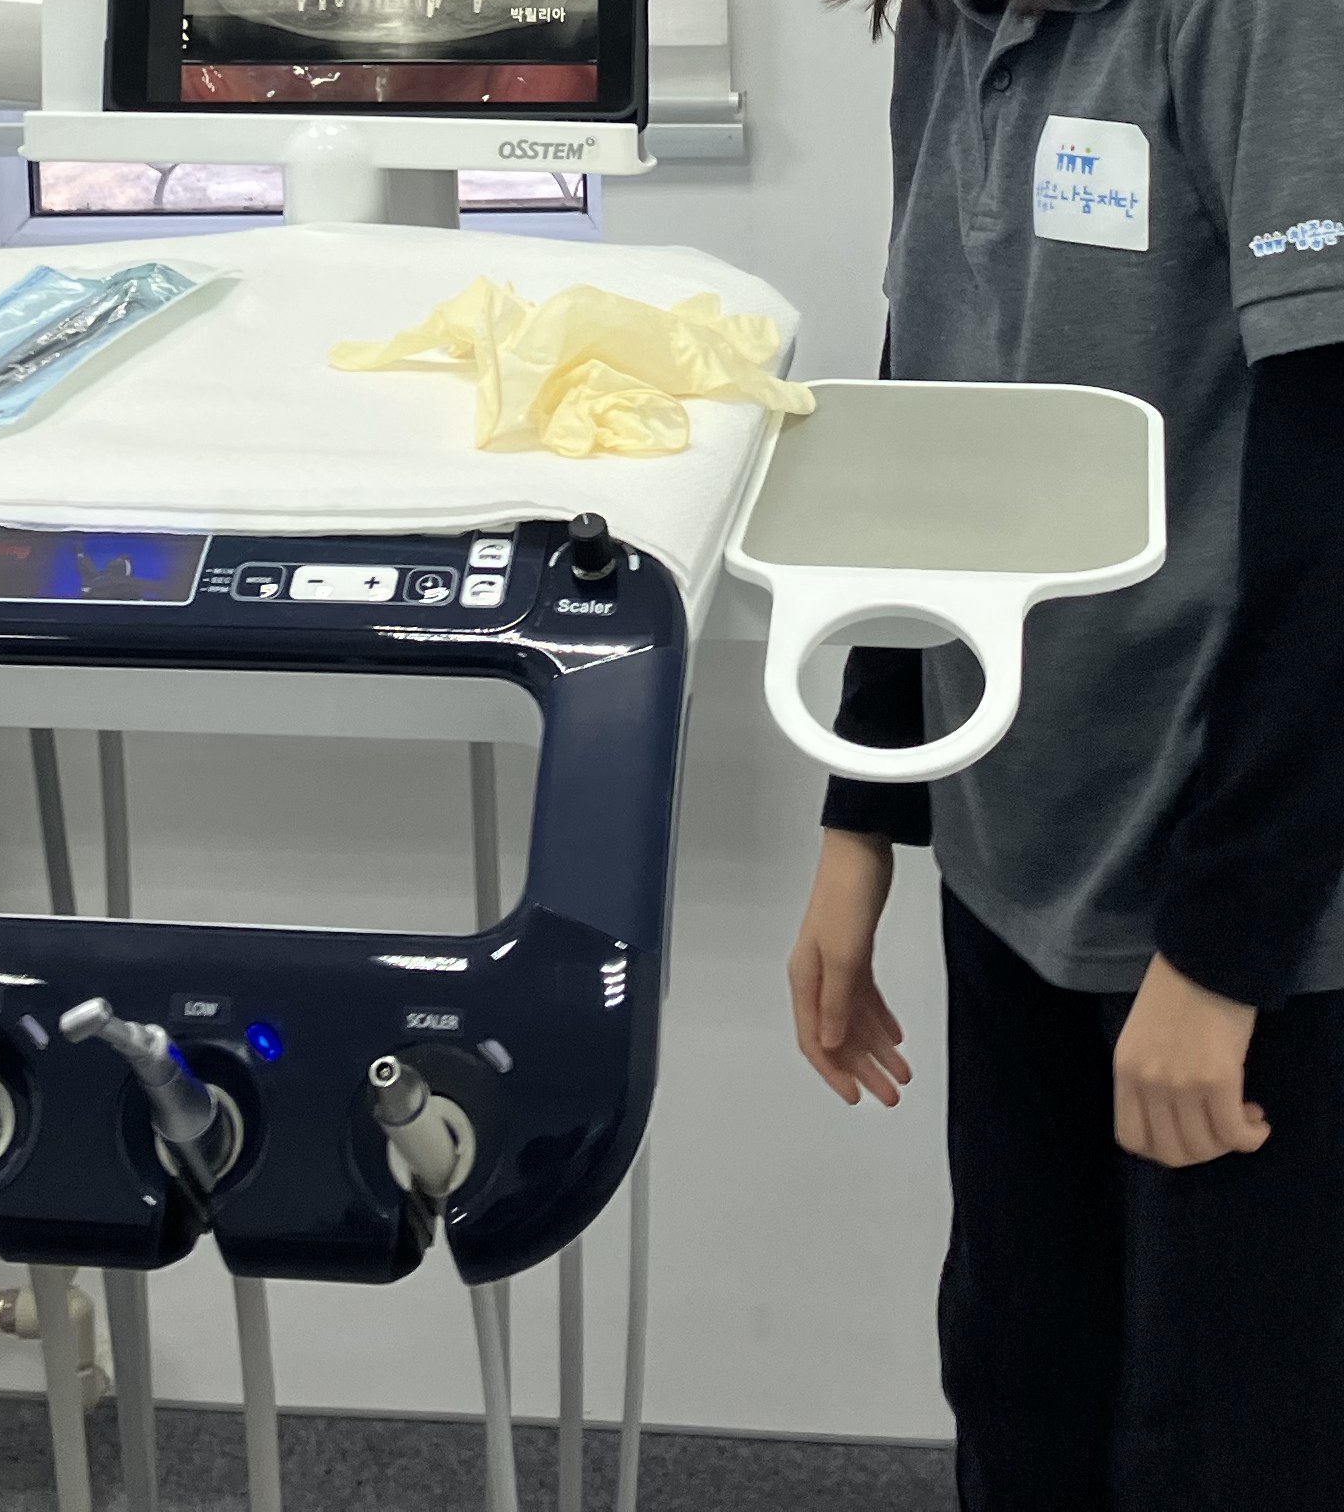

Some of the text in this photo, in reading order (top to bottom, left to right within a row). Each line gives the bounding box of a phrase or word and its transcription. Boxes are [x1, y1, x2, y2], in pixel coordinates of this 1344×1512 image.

[498, 139, 585, 160] OSSTEM
[556, 598, 613, 615] Scaler
[184, 1001, 219, 1016] LOW
[406, 1013, 459, 1030] SCALER
